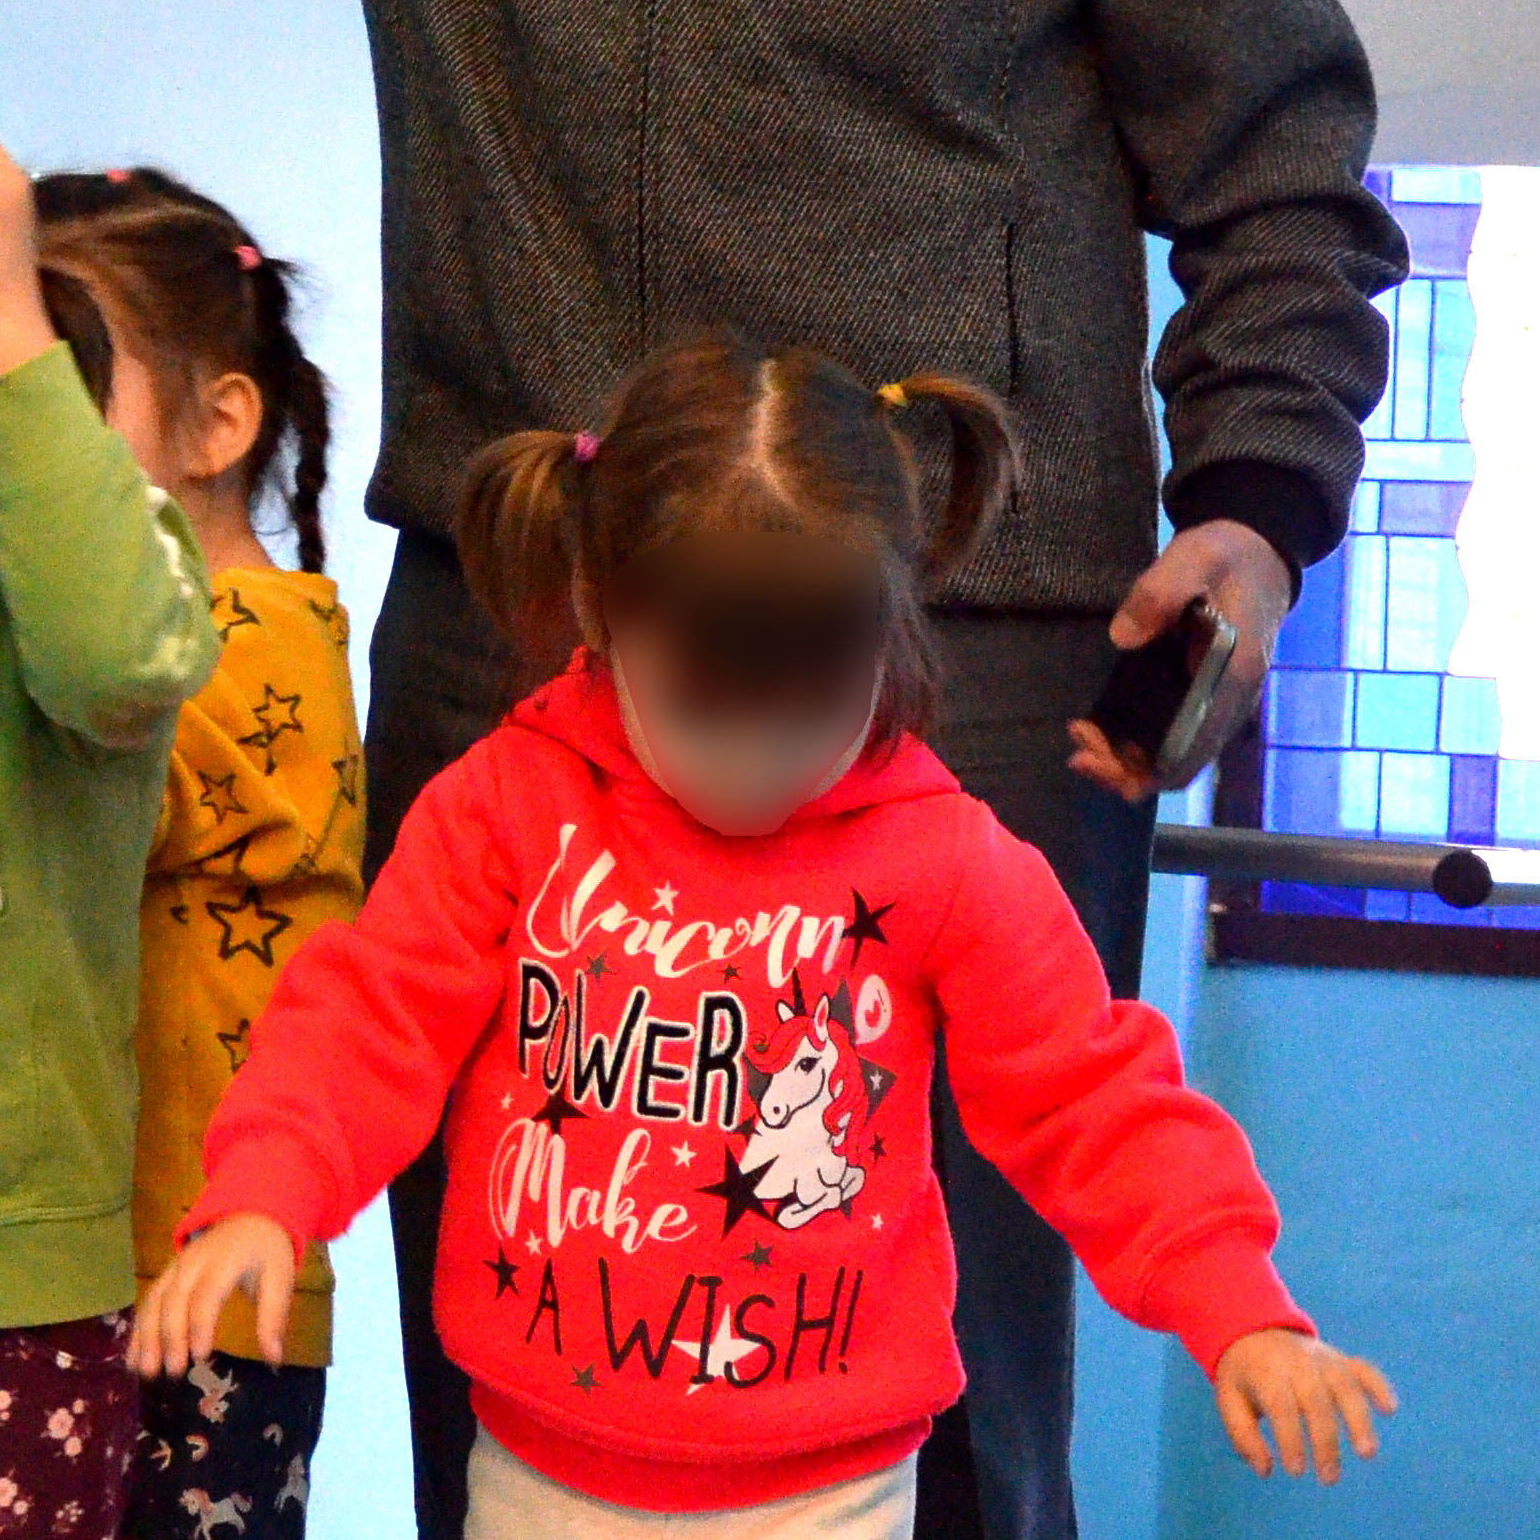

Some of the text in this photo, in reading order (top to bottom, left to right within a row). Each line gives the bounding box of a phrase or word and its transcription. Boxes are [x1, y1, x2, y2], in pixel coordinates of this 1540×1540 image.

[526, 823, 848, 988] Unicorn
[516, 957, 748, 1131] POWER
[489, 1117, 697, 1254] Make
[524, 1256, 863, 1390] A WISH!
